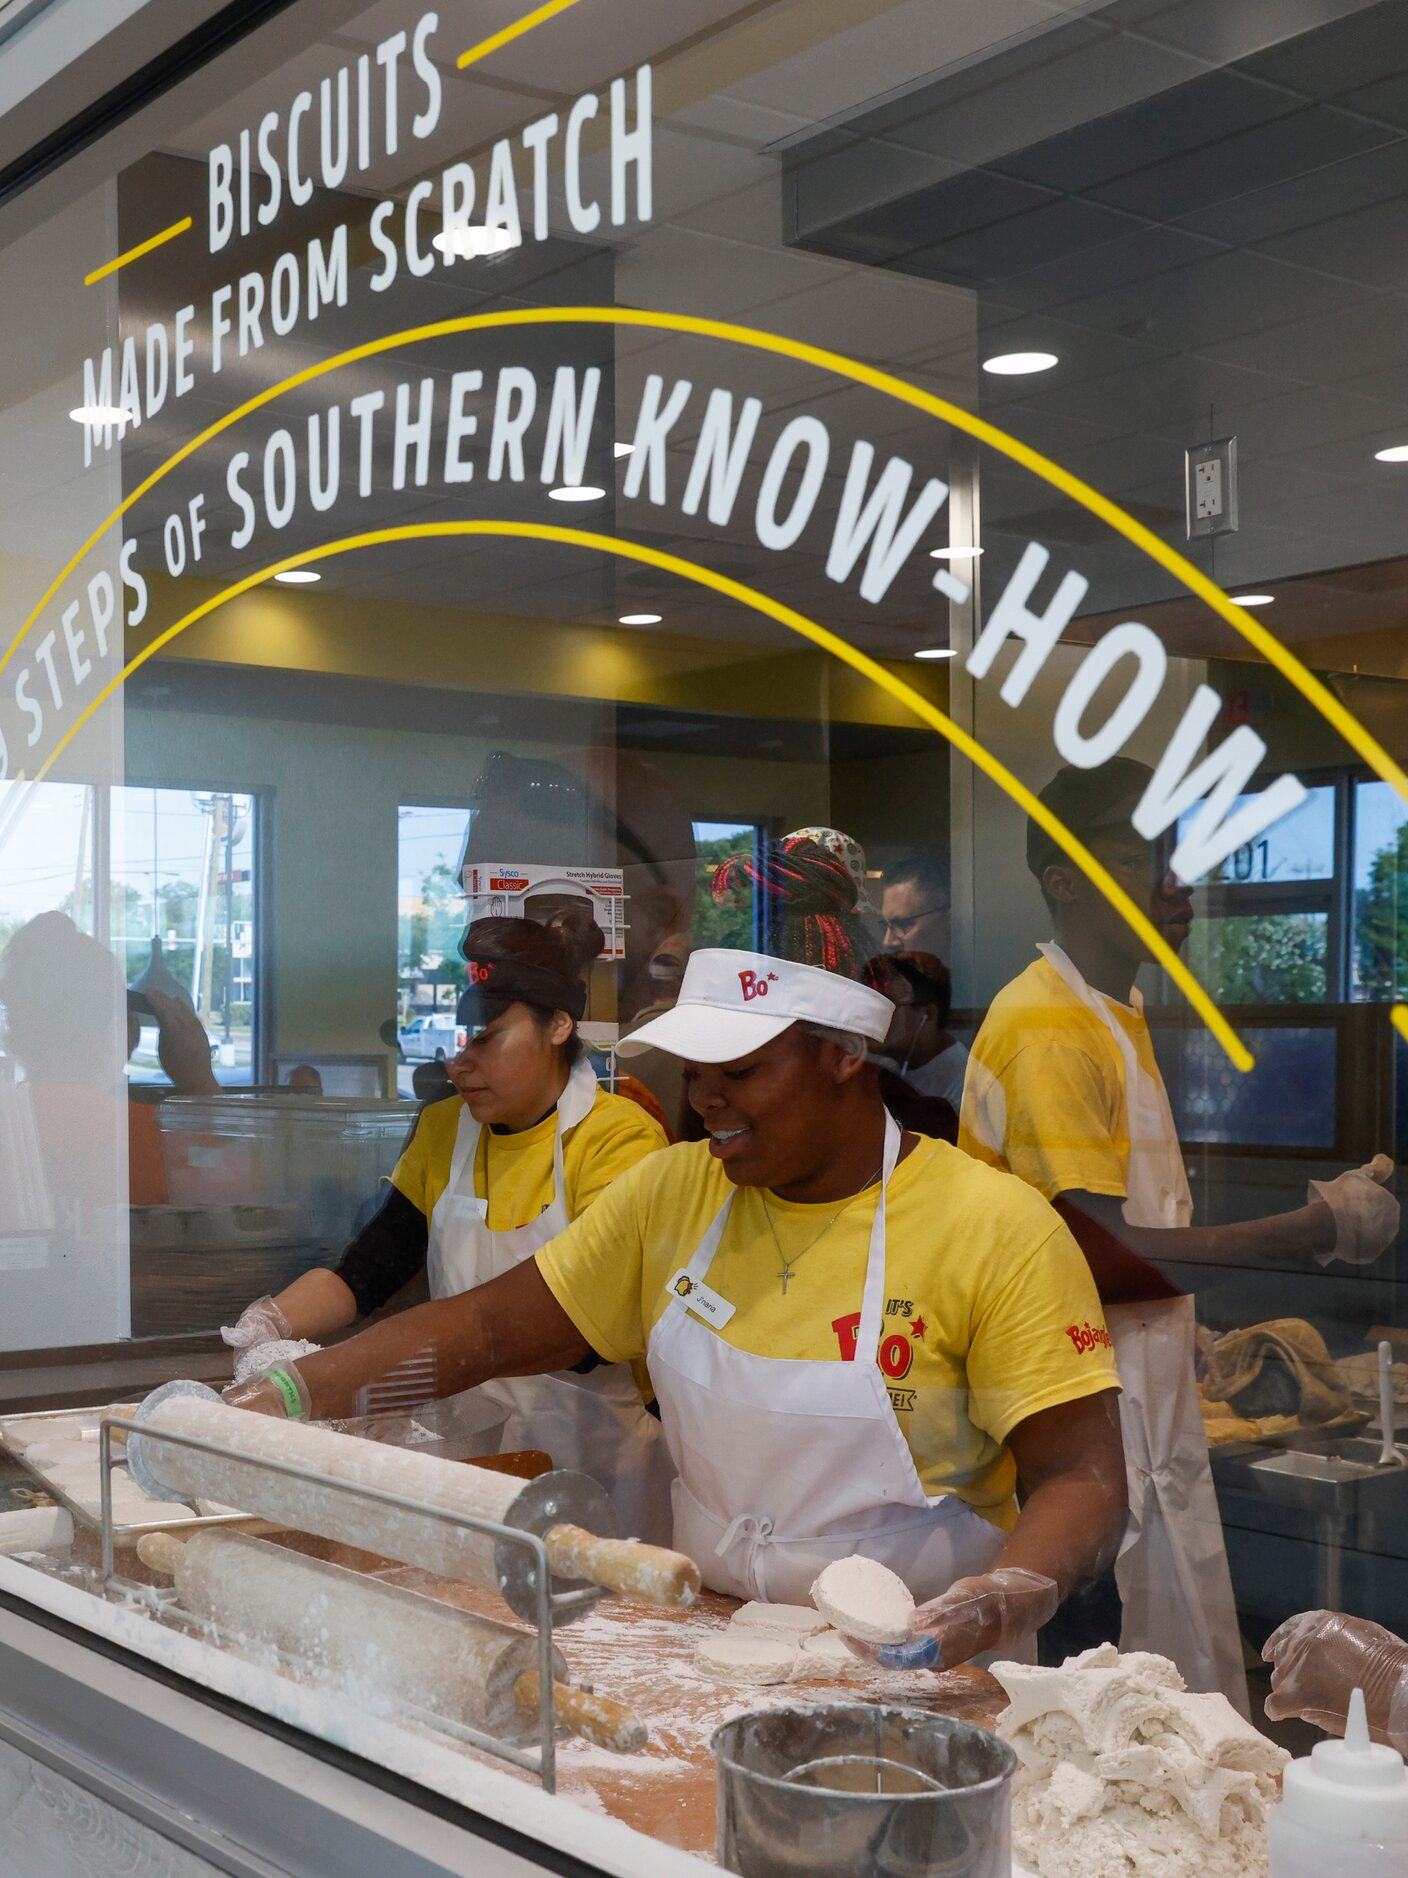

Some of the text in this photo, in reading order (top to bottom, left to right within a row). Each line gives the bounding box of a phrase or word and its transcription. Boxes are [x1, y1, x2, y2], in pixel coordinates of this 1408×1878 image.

[209, 11, 442, 254] BISCUITS
[84, 63, 653, 468] MADE FROM SCRATCH
[15, 537, 149, 748] STEPS
[163, 493, 206, 578] OF
[226, 366, 601, 549] SOUTHERN
[623, 373, 1308, 886] KNOW-HOW
[496, 879, 523, 890] Classic
[499, 868, 519, 878] Sysco
[465, 961, 488, 984] Bo
[738, 970, 768, 1001] Bo
[885, 1299, 913, 1317] IT'S
